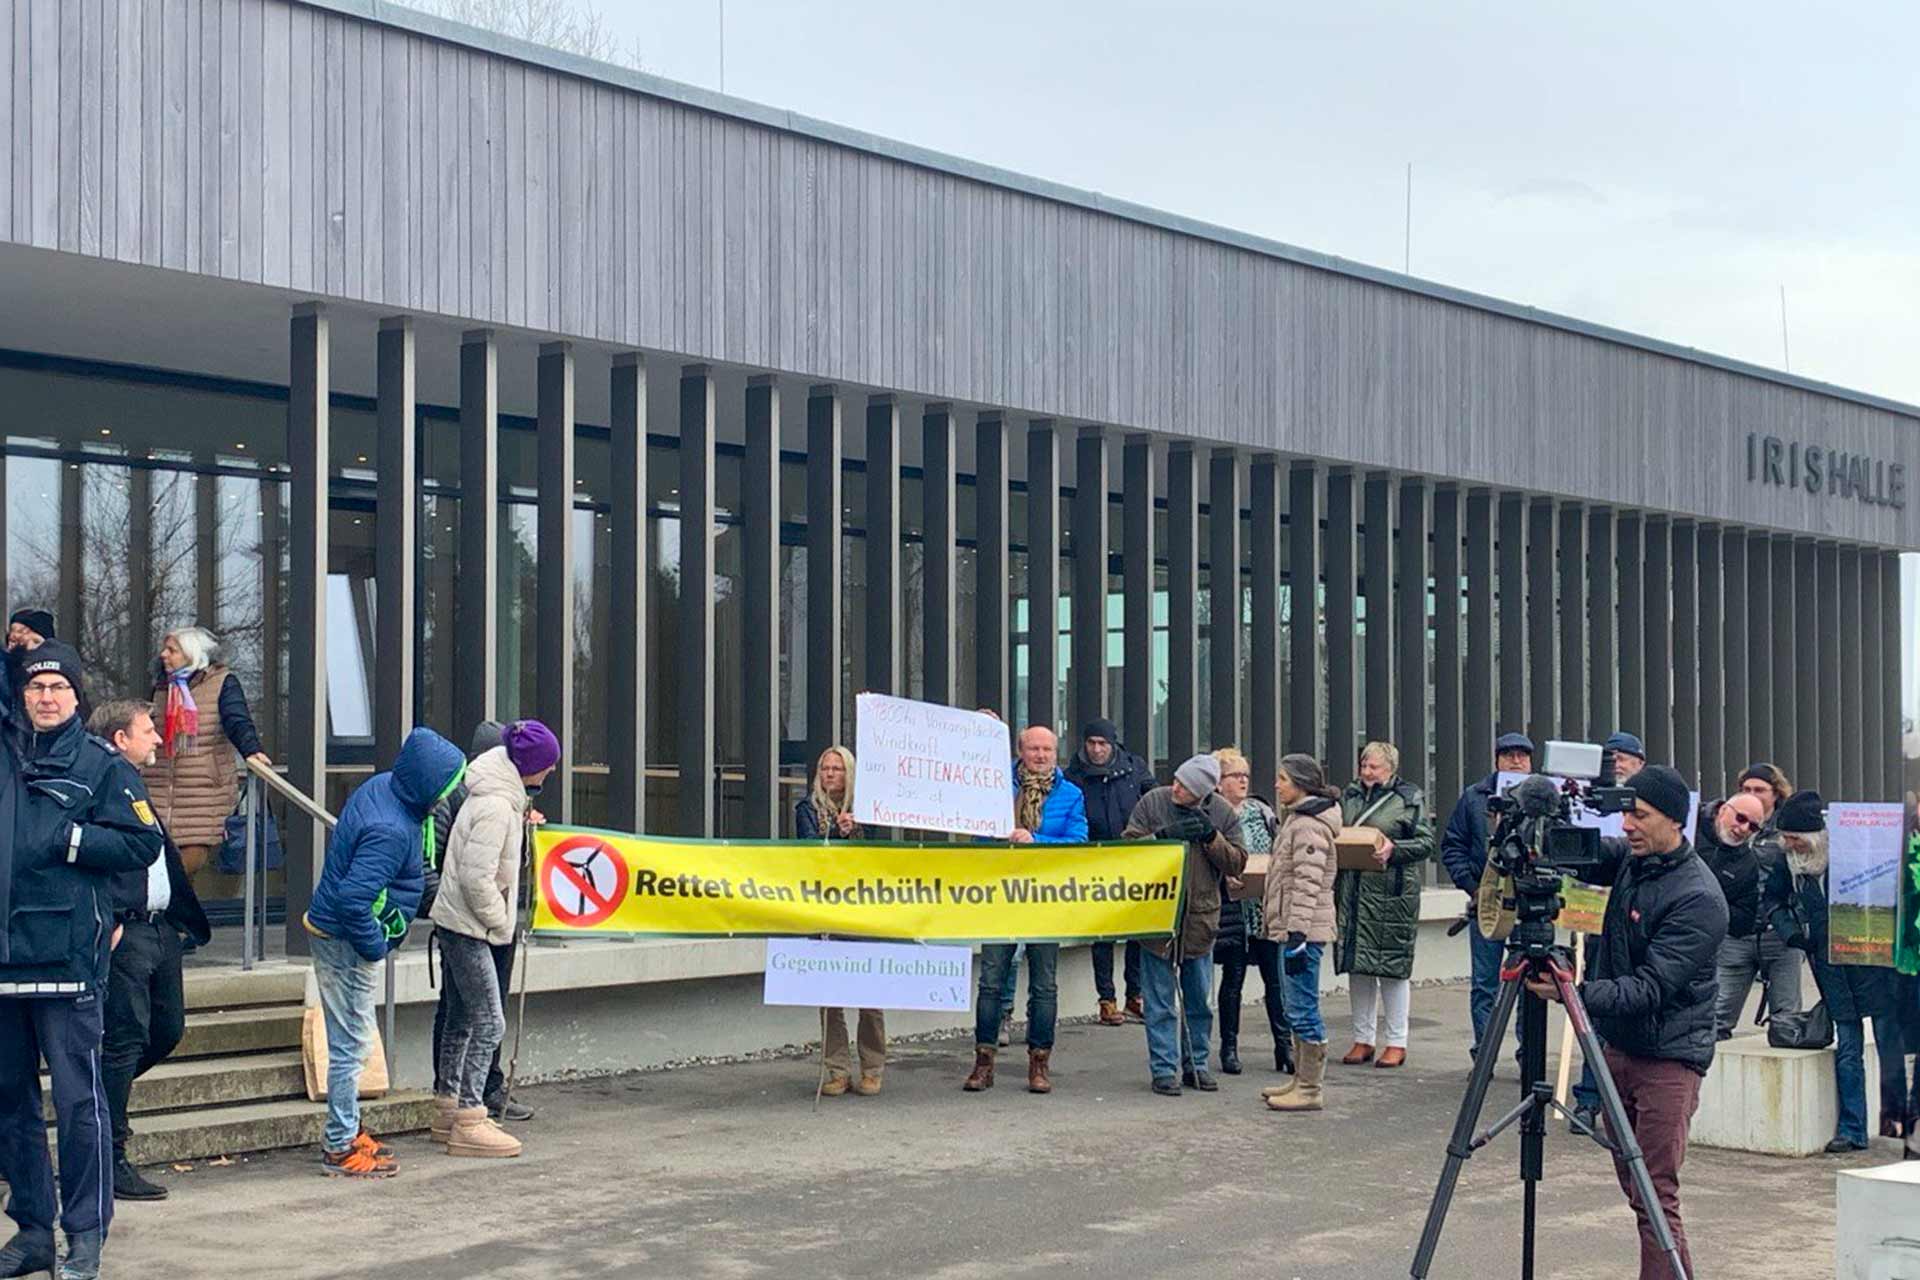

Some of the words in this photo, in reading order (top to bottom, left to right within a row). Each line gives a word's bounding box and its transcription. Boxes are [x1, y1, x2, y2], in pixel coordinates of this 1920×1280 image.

[1747, 432, 1906, 510] IRISHALLE
[26, 661, 60, 674] POLIZEI
[865, 761, 887, 776] um
[897, 755, 1006, 790] KETTENACKER
[635, 869, 734, 899] Rettet
[739, 878, 795, 901] den
[801, 878, 941, 905] Hochbühl
[948, 885, 997, 904] vor
[1001, 876, 1178, 903] Windrädern!
[772, 952, 872, 974] Gegenwind
[880, 957, 966, 977] Hochbühl
[929, 989, 944, 1002] e.
[949, 986, 966, 1003] V.
